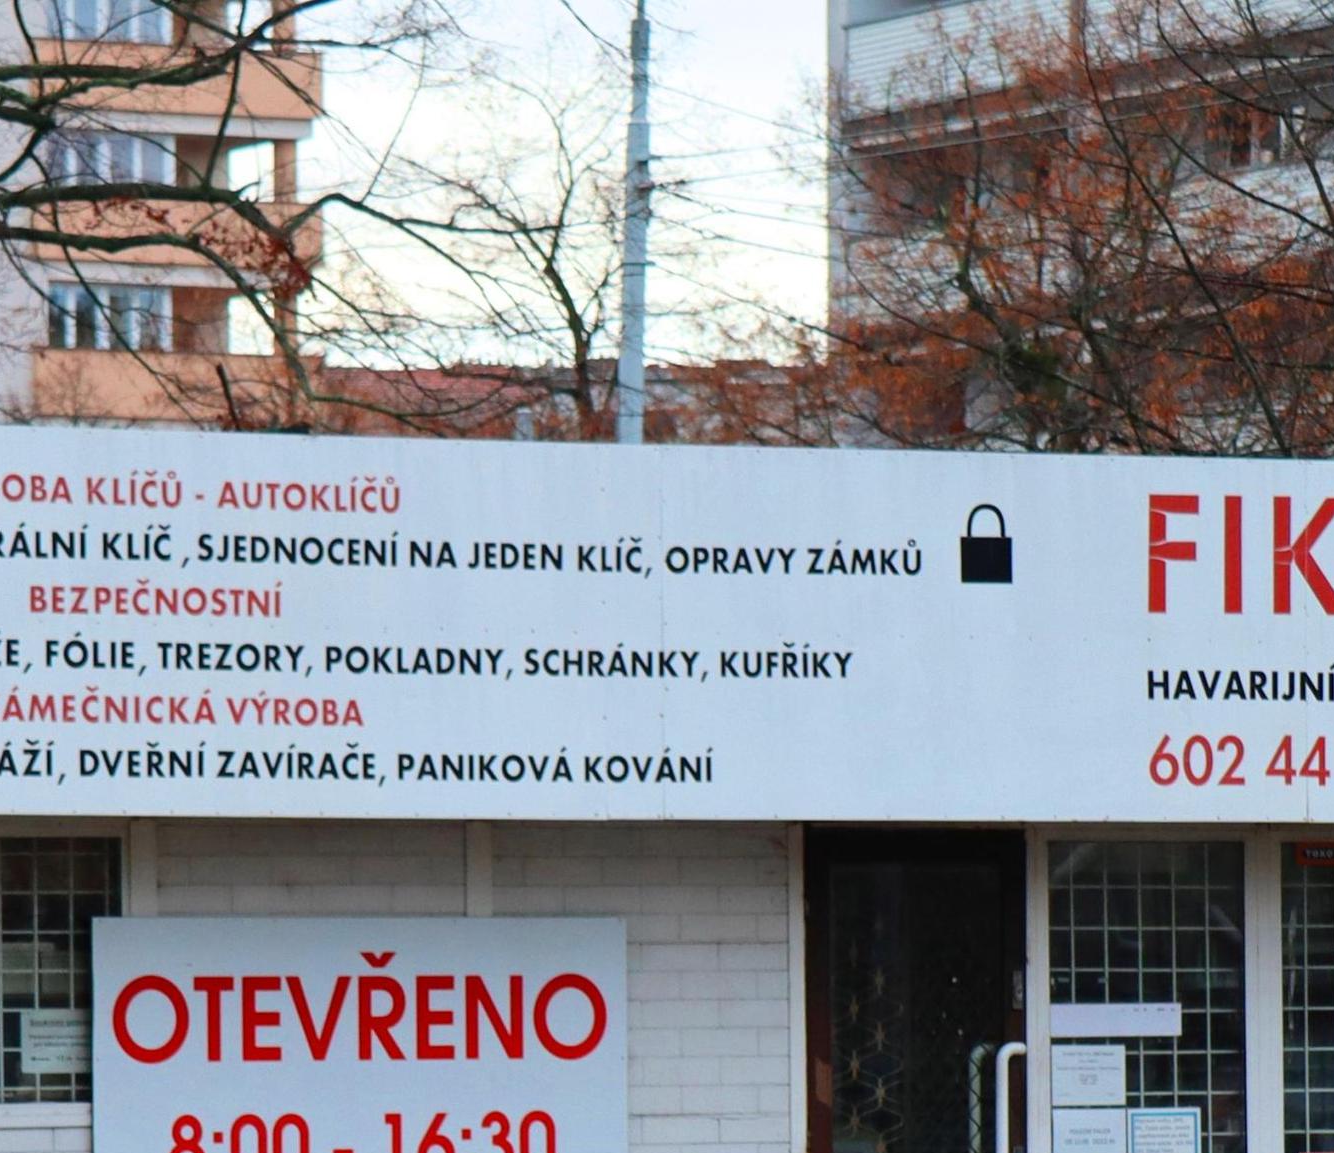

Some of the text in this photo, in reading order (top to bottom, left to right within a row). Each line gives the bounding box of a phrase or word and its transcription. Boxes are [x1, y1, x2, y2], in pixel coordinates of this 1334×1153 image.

[86, 470, 182, 509] KLÍČŮ
[217, 476, 401, 514] AUTOKLÍČŮ
[409, 540, 458, 569] NA
[467, 541, 564, 571] JEDEN
[577, 536, 652, 579] KLÍČ,
[664, 545, 797, 575] OPRAVY
[806, 538, 922, 577] ZÁMKŮ
[29, 579, 282, 618] BEZPEČNOSTNÍ
[45, 631, 147, 677] FÓLIE,
[156, 641, 313, 678] TREZORY,
[325, 645, 513, 680] POKLADNY,
[524, 642, 708, 683] SCHRÁNKY,
[720, 641, 853, 679] KUFŘÍKY
[226, 691, 364, 727] VÝROBA
[79, 740, 206, 778] DVEŘNÍ
[216, 742, 386, 787] ZAVÍRAČE,
[397, 746, 574, 783] PANIKOVÁ
[584, 747, 713, 784] KOVÁNÍ
[1148, 734, 1246, 787] 602
[1265, 734, 1331, 787] 44
[111, 951, 608, 1065] OTEVŘENO
